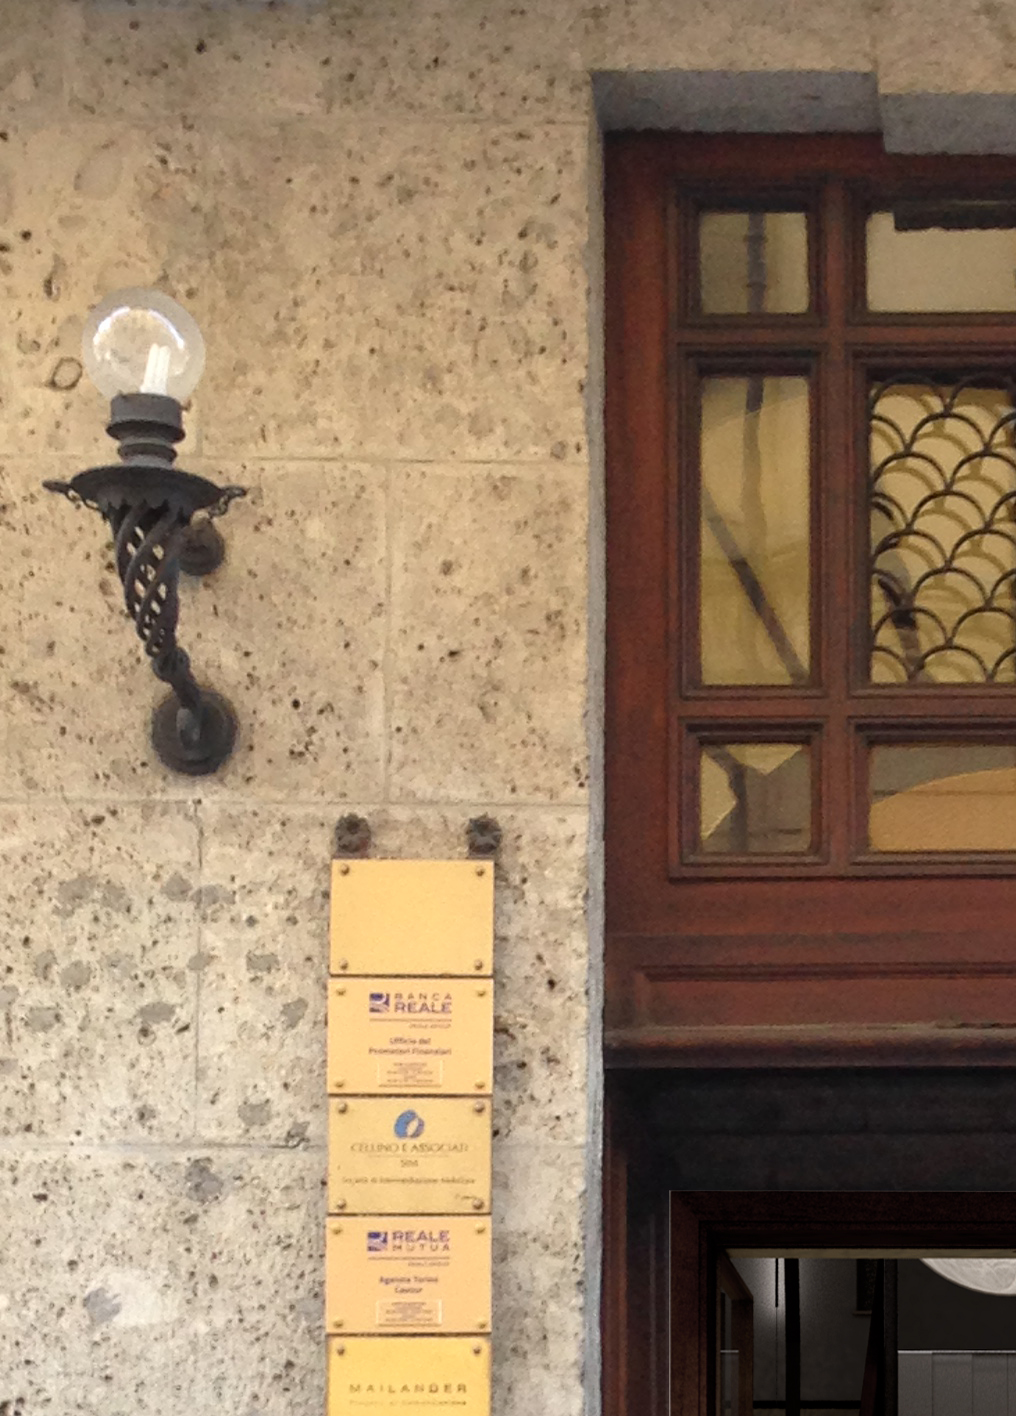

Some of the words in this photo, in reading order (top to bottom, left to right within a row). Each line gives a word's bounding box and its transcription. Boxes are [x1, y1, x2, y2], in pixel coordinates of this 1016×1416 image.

[394, 992, 452, 1000] BANCA
[394, 1002, 452, 1014] REALE
[392, 1230, 450, 1242] REALE
[392, 1243, 450, 1251] MUTUA
[349, 1383, 467, 1393] MAILANDER
